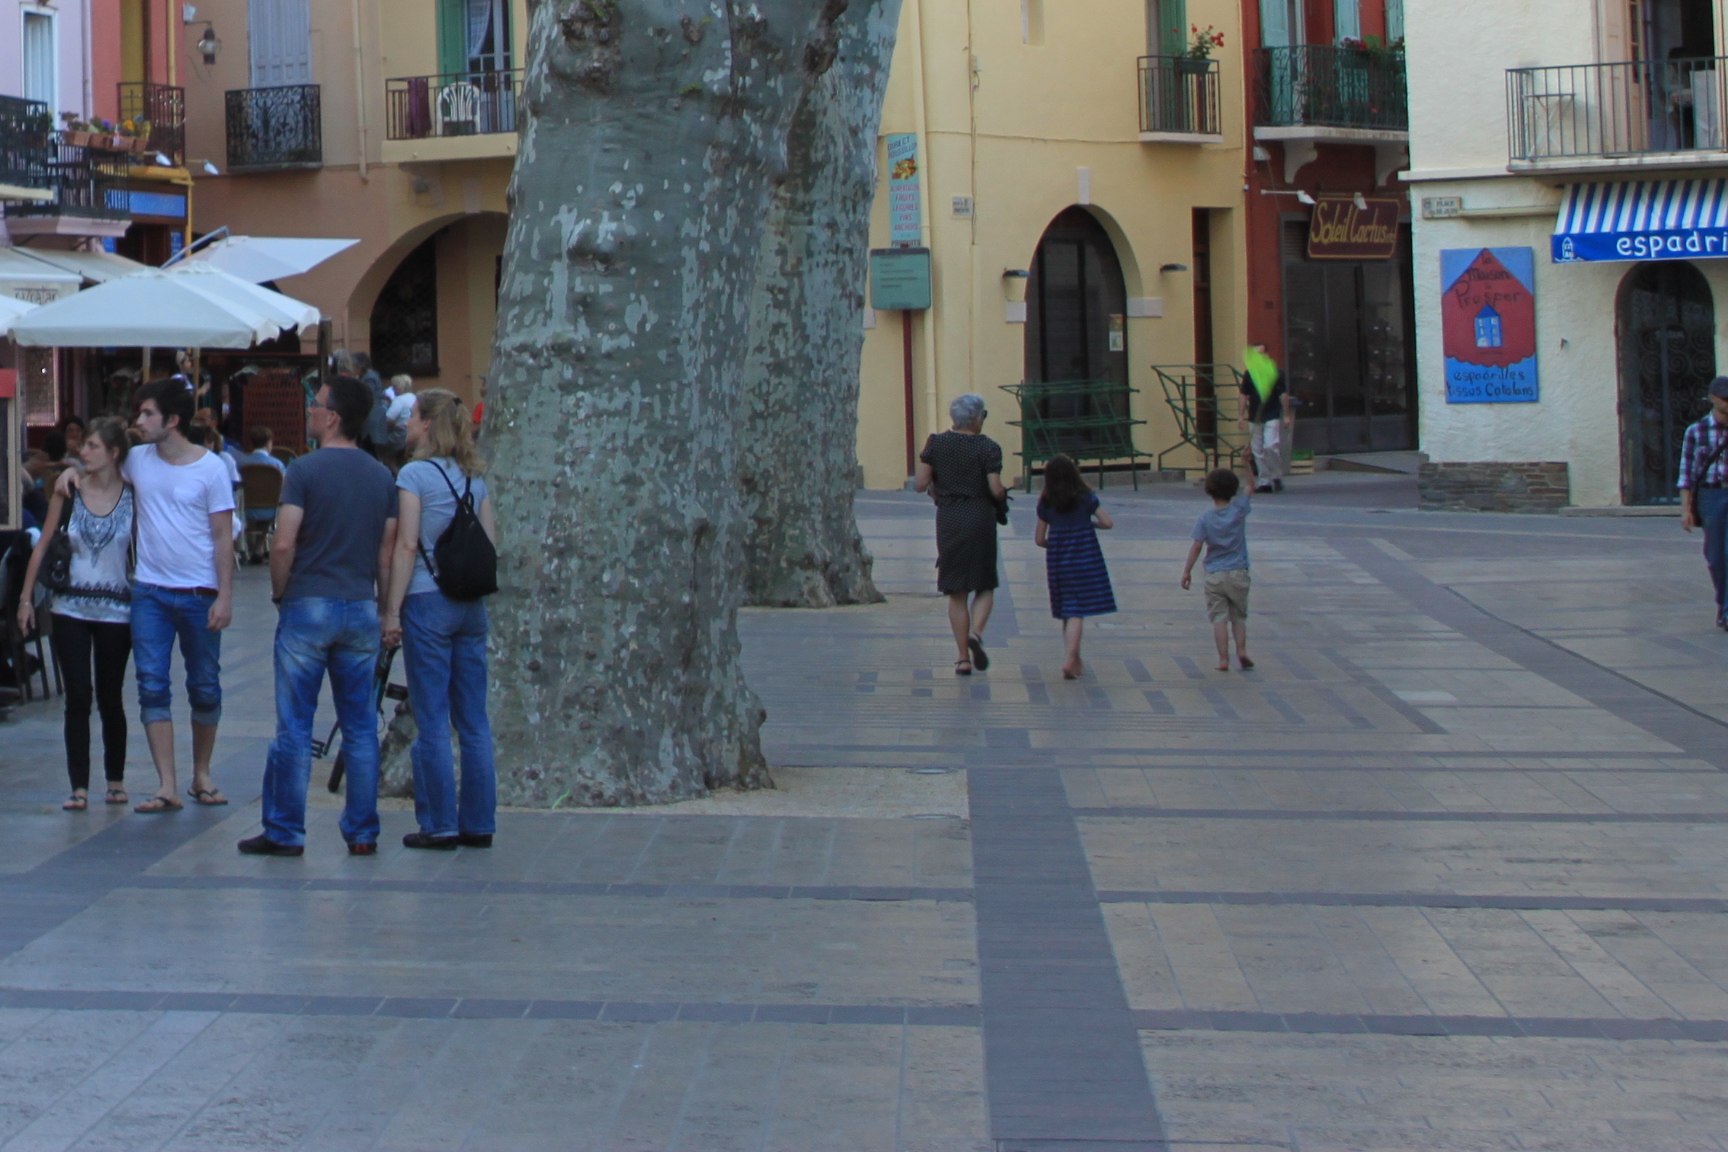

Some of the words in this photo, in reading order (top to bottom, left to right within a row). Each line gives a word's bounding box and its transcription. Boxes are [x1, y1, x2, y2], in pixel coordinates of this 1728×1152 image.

[887, 135, 911, 151] DIRECT
[1311, 202, 1353, 245] Soleil
[1350, 206, 1388, 243] Cactus
[1616, 229, 1728, 258] espadri
[1467, 267, 1512, 282] Maison
[1455, 280, 1521, 310] Prosper
[1453, 367, 1526, 385] espadrilles
[1445, 380, 1482, 398] tissus
[1485, 381, 1535, 397] Catalans
